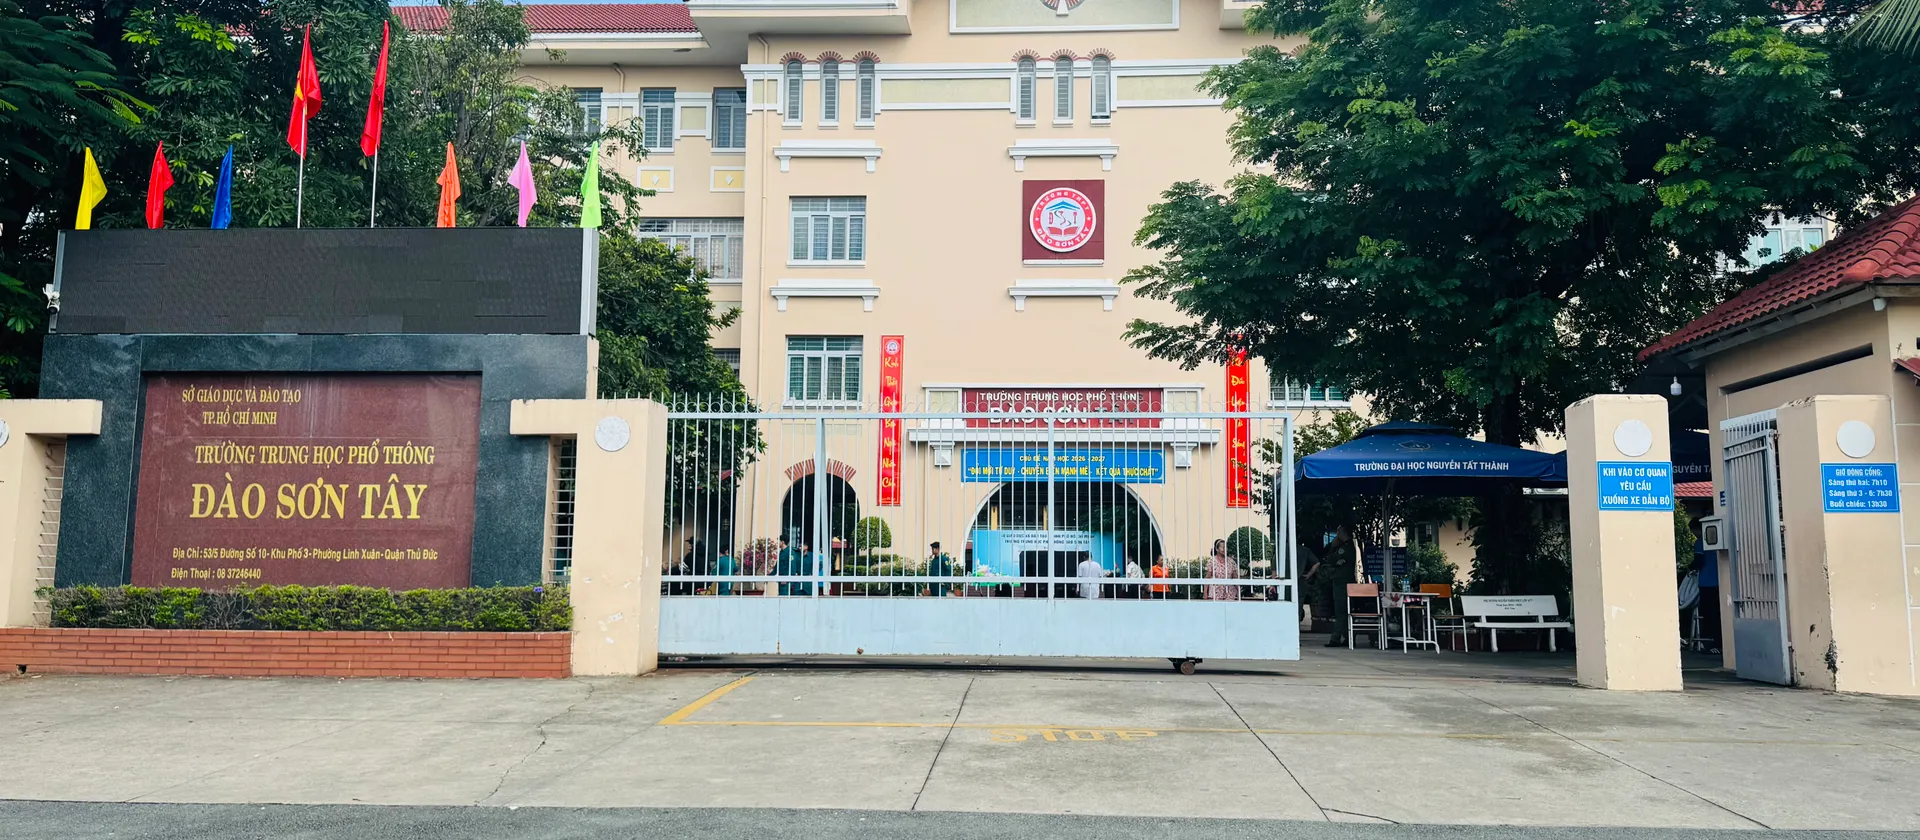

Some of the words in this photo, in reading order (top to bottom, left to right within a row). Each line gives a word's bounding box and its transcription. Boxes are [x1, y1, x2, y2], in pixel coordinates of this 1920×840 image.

[182, 384, 195, 403] SỞ
[196, 385, 221, 403] GIÁO
[222, 389, 243, 405] DỤC
[245, 386, 257, 403] VÀ
[259, 385, 280, 403] ĐÀO
[282, 389, 301, 405] TẠO
[1025, 392, 1059, 401] TRUNG
[203, 404, 230, 425] TP.HỒ
[232, 407, 251, 425] CHÍ
[251, 411, 277, 425] MINH
[195, 441, 256, 465] TRƯỜNG
[259, 445, 310, 465] TRUNG
[312, 445, 344, 469] HỌC
[347, 438, 381, 465] PHỔ
[382, 440, 435, 465] THÔNG
[1354, 460, 1389, 472] TRƯỜNG
[1390, 461, 1405, 472] ĐẠI
[1407, 461, 1426, 472] HỌC
[1426, 459, 1461, 471] NGUYỄN
[1462, 459, 1478, 471] TẤT
[1479, 460, 1509, 471] THÀNH
[1603, 467, 1616, 477] KHI
[1617, 466, 1633, 477] VÀO
[1634, 467, 1646, 477] CƠ
[1646, 467, 1667, 478] QUAN
[1619, 480, 1635, 491] YÊU
[1871, 478, 1888, 486] 7h10
[189, 471, 267, 519] ĐÀO
[276, 477, 349, 520] SƠN
[358, 473, 428, 519] TÂY
[1602, 492, 1629, 505] XUỐNG
[1630, 495, 1640, 505] XE
[1659, 494, 1671, 507] BỘ
[1858, 489, 1863, 497] 3
[1876, 489, 1893, 497] 7h30
[1867, 500, 1888, 508] 13h30
[173, 547, 185, 560] Địa
[203, 547, 218, 559] 53/5
[220, 548, 244, 561] Đường
[245, 546, 257, 559] Số
[271, 548, 286, 559] Khu
[287, 546, 303, 559] Phố
[313, 548, 341, 562] Phường
[343, 548, 359, 560] Linh
[385, 548, 405, 562] Quận
[406, 547, 421, 560] Thủ
[423, 548, 438, 560] Đức
[171, 567, 188, 580] Điện
[190, 567, 211, 580] Thoại
[216, 568, 226, 579] 08
[227, 568, 262, 579] 37246440
[990, 728, 1159, 743] STOP
